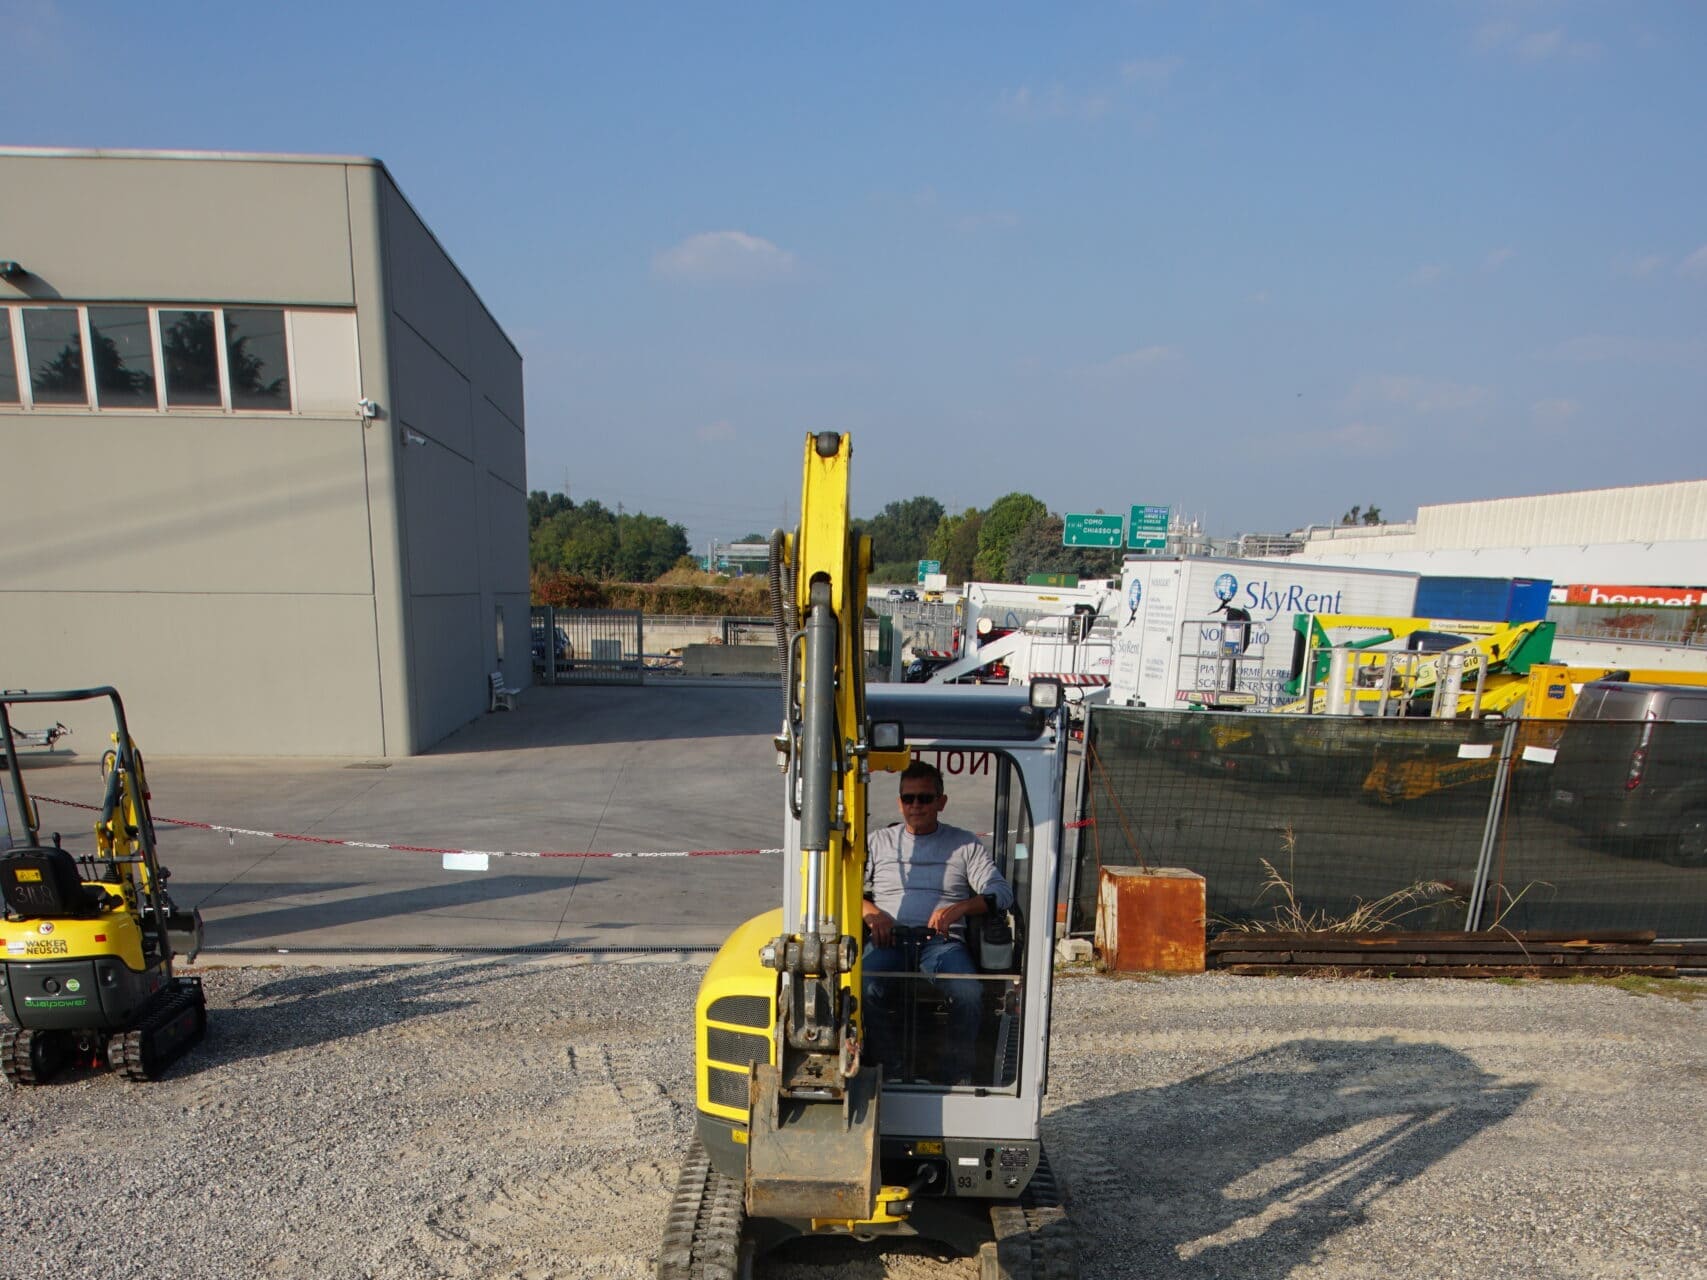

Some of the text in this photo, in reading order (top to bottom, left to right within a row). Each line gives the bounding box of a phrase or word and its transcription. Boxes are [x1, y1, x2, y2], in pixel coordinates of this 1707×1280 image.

[1084, 518, 1103, 526] COMO
[1083, 527, 1112, 535] CHIASSO
[1243, 581, 1343, 622] SkyRent
[25, 939, 67, 947] WACKER
